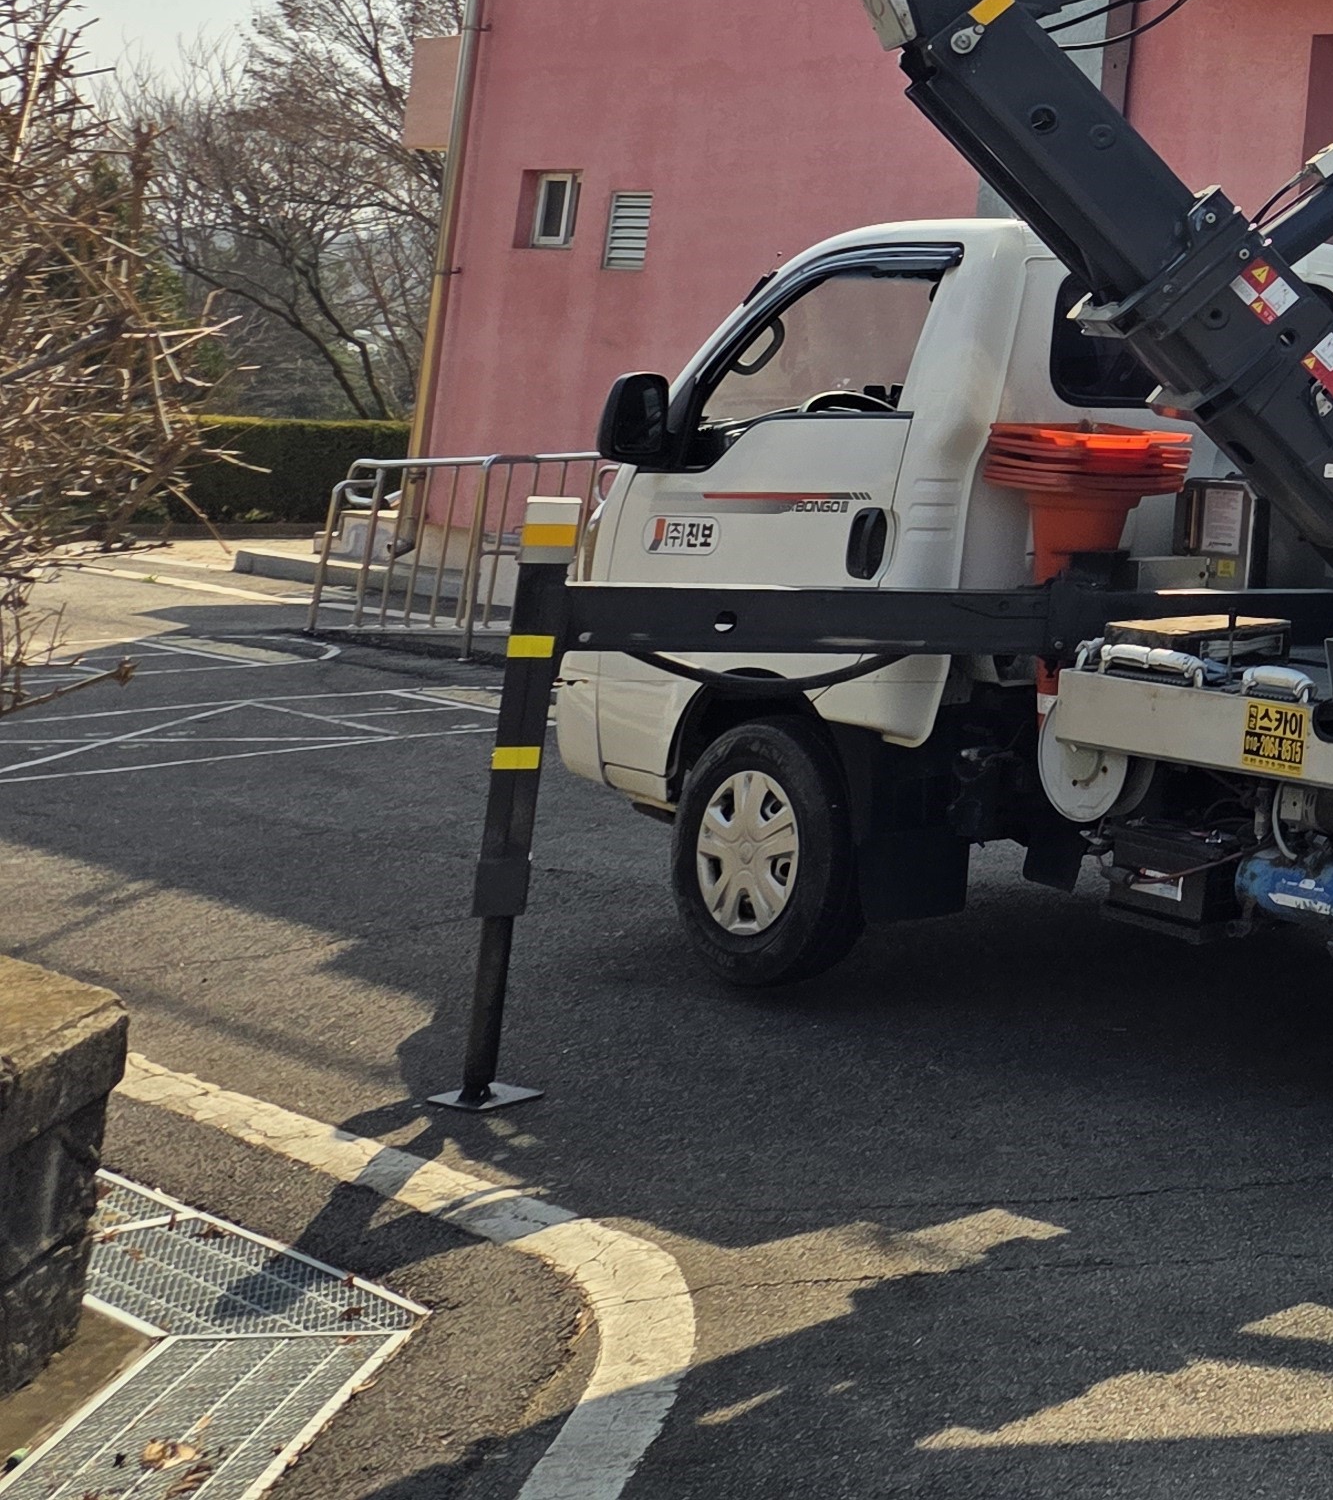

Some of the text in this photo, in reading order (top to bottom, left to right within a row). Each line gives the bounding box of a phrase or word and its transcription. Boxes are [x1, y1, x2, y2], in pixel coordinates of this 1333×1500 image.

[795, 500, 840, 513] BONGO
[664, 522, 714, 548] (주)진보
[1258, 707, 1303, 739] 스카이
